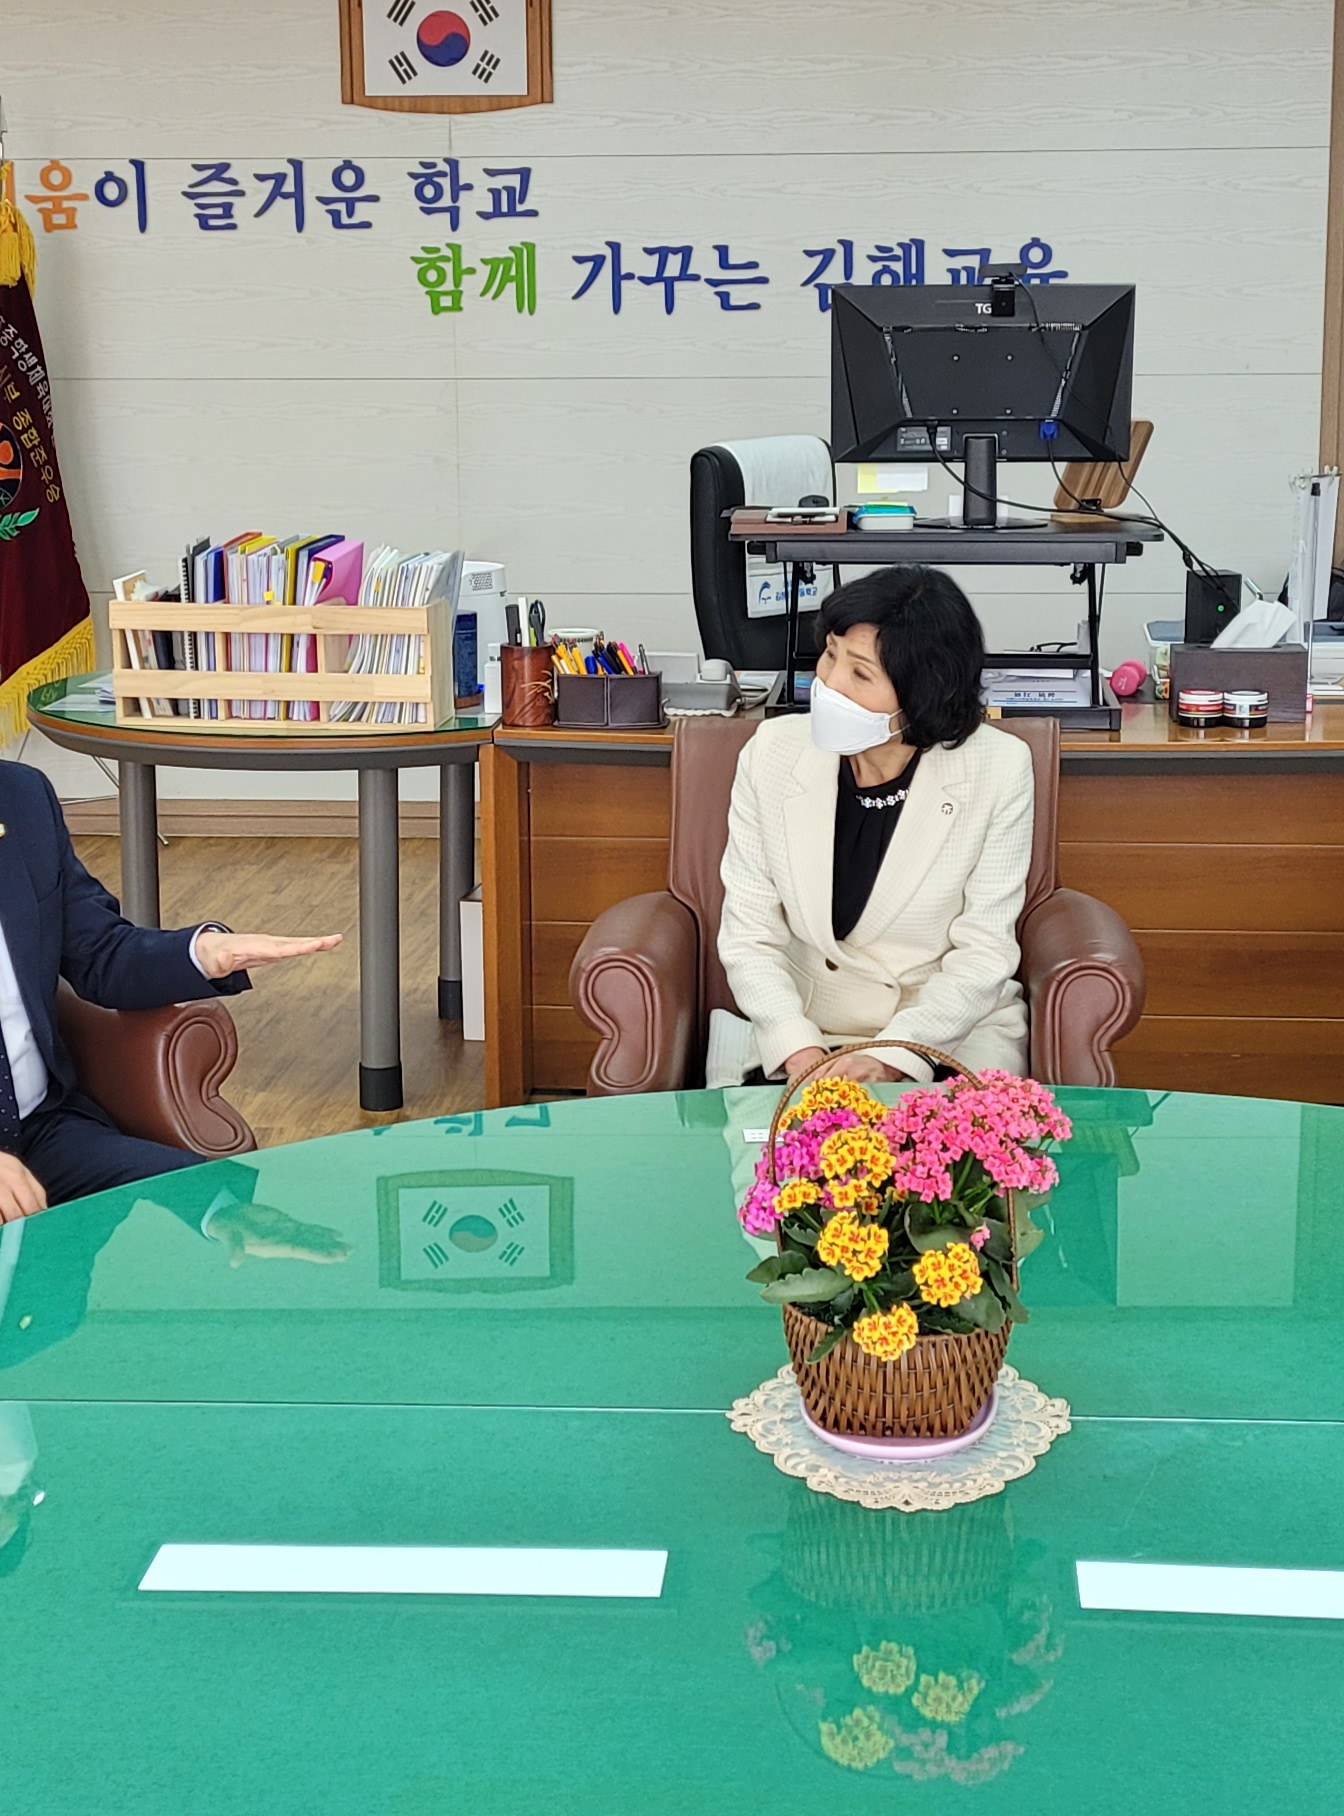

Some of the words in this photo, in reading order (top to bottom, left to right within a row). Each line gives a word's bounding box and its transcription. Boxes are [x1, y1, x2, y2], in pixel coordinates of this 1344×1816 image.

[181, 159, 381, 232] 즐거운
[406, 158, 540, 232] 학교
[409, 241, 537, 316] 함께
[572, 240, 770, 316] 가꾸는
